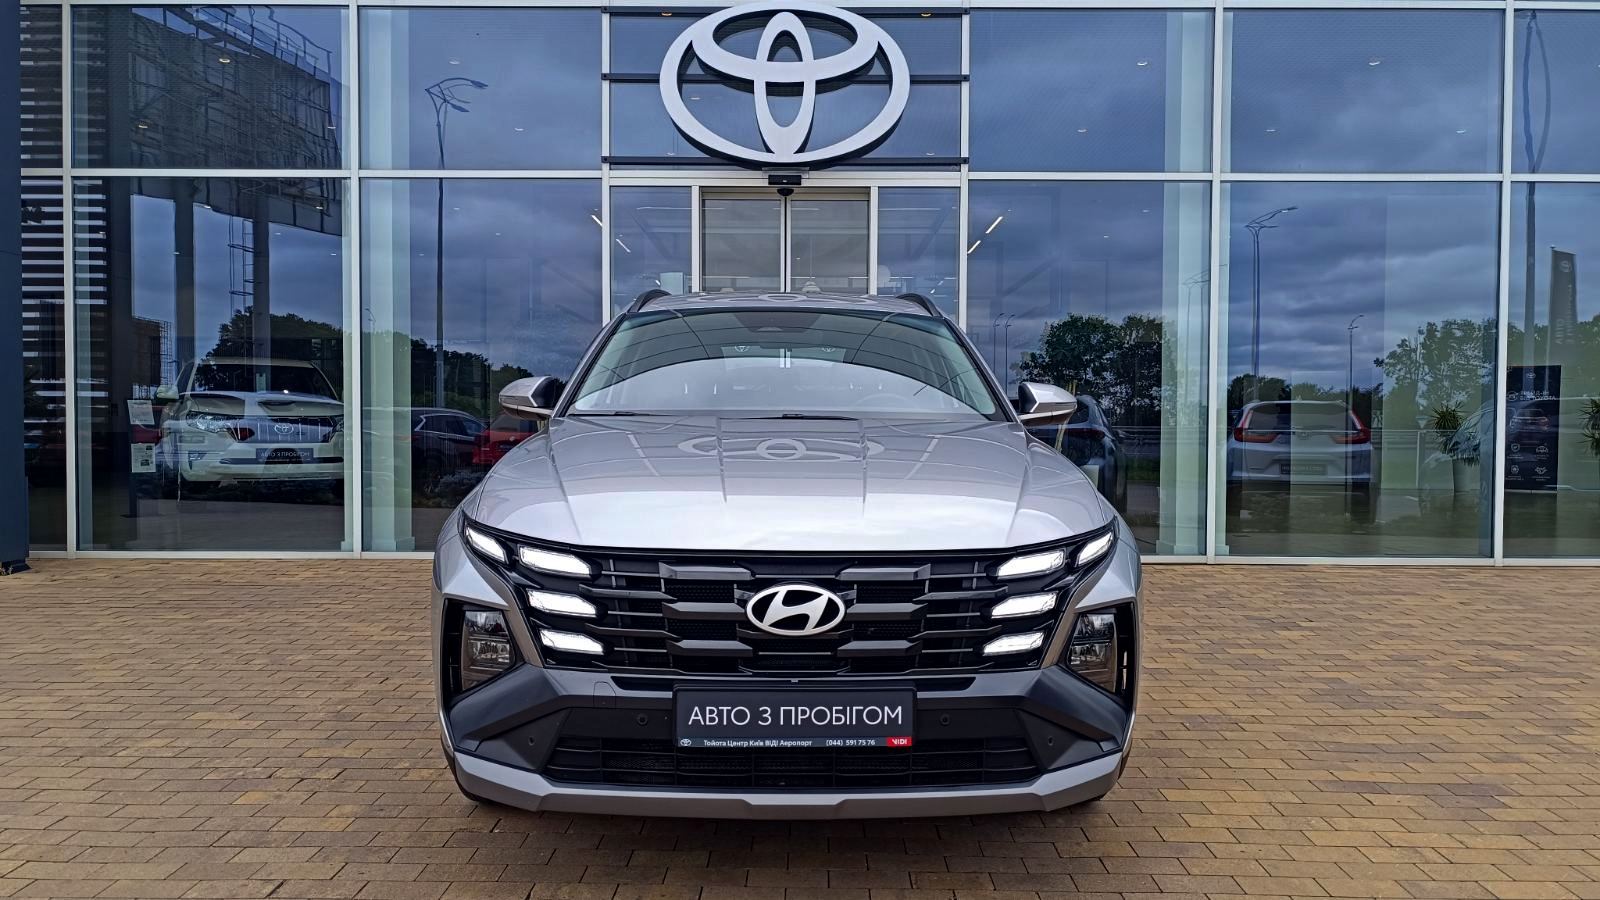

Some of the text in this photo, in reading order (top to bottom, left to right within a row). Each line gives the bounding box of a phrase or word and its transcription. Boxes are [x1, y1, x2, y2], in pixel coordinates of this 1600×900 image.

[688, 706, 902, 726] АВТО З ПРОБІГОМ
[704, 739, 726, 747] Тойота
[727, 740, 749, 748] Центр
[749, 739, 764, 747] Київ
[779, 740, 813, 748] Аеропорт
[826, 739, 843, 747] (044)
